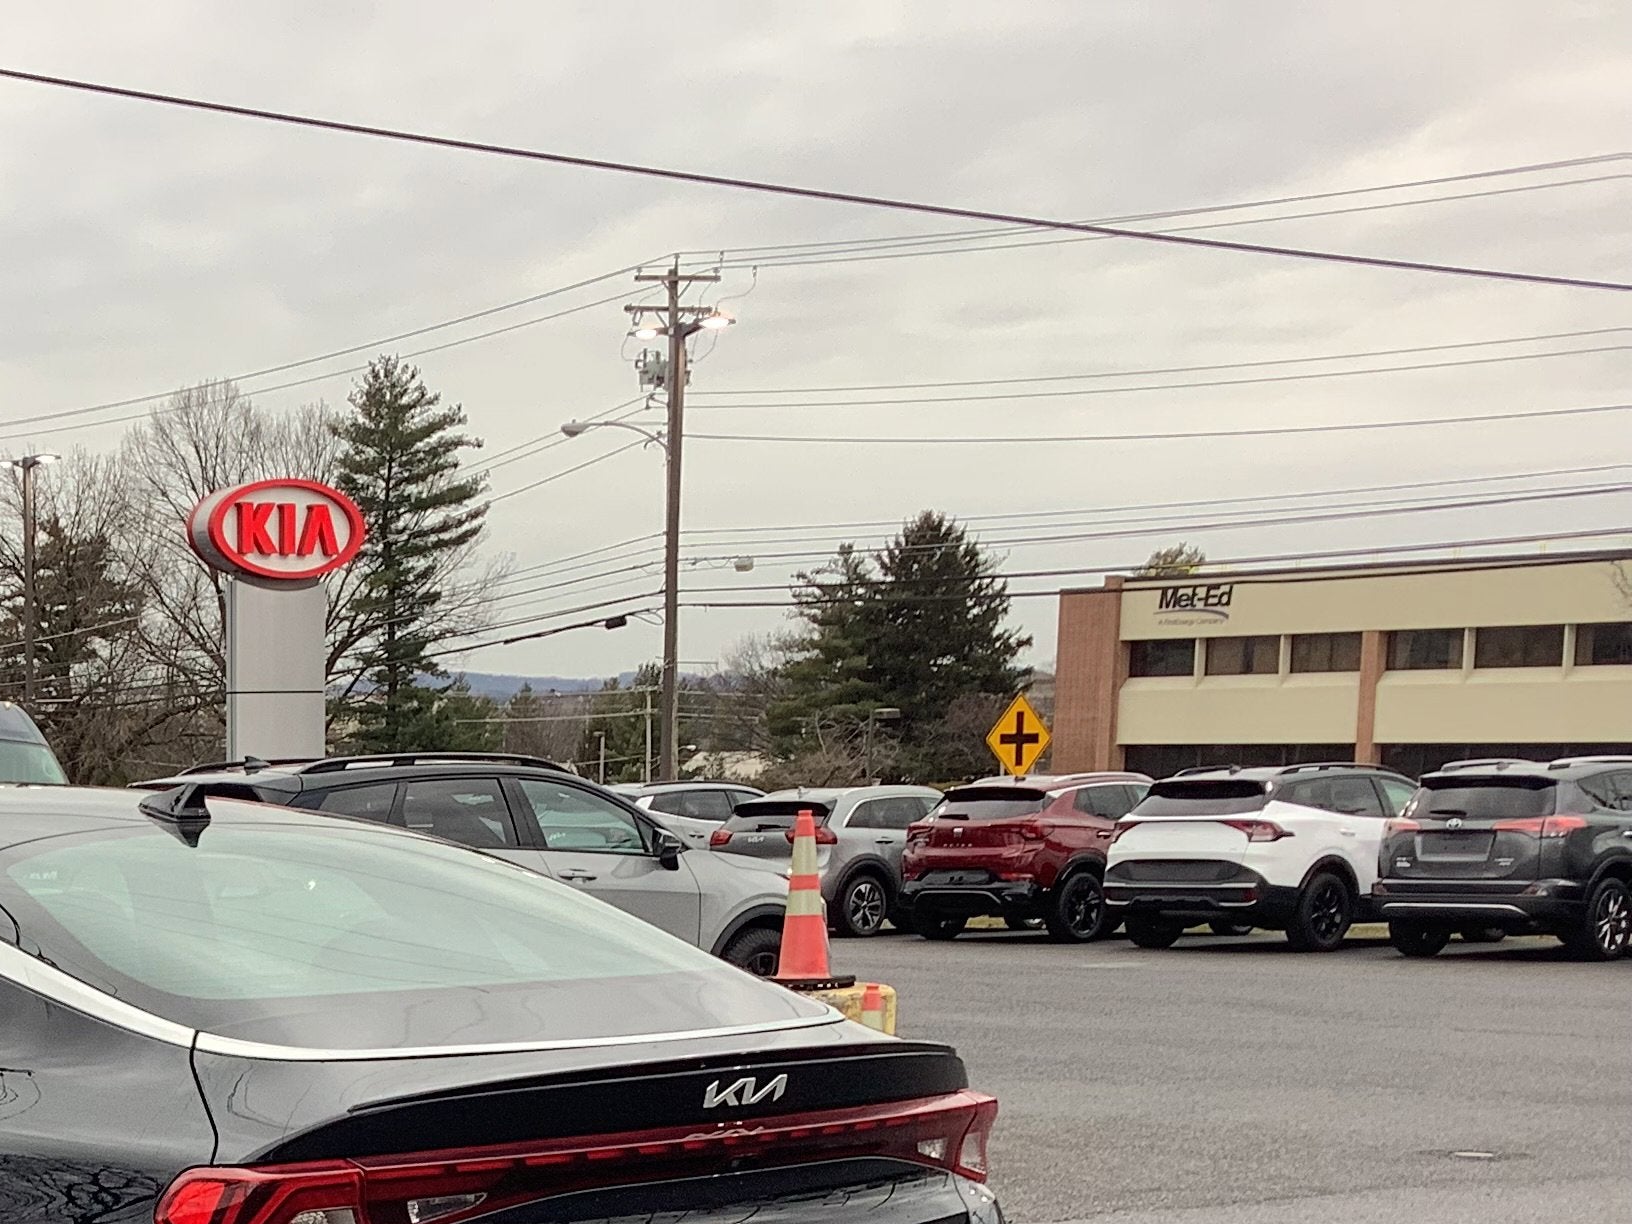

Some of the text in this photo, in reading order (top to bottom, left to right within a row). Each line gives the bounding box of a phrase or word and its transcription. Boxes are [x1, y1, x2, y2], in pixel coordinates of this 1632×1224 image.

[236, 502, 340, 556] KIA
[1158, 584, 1233, 609] Met-Ed
[703, 1074, 788, 1108] KIA
